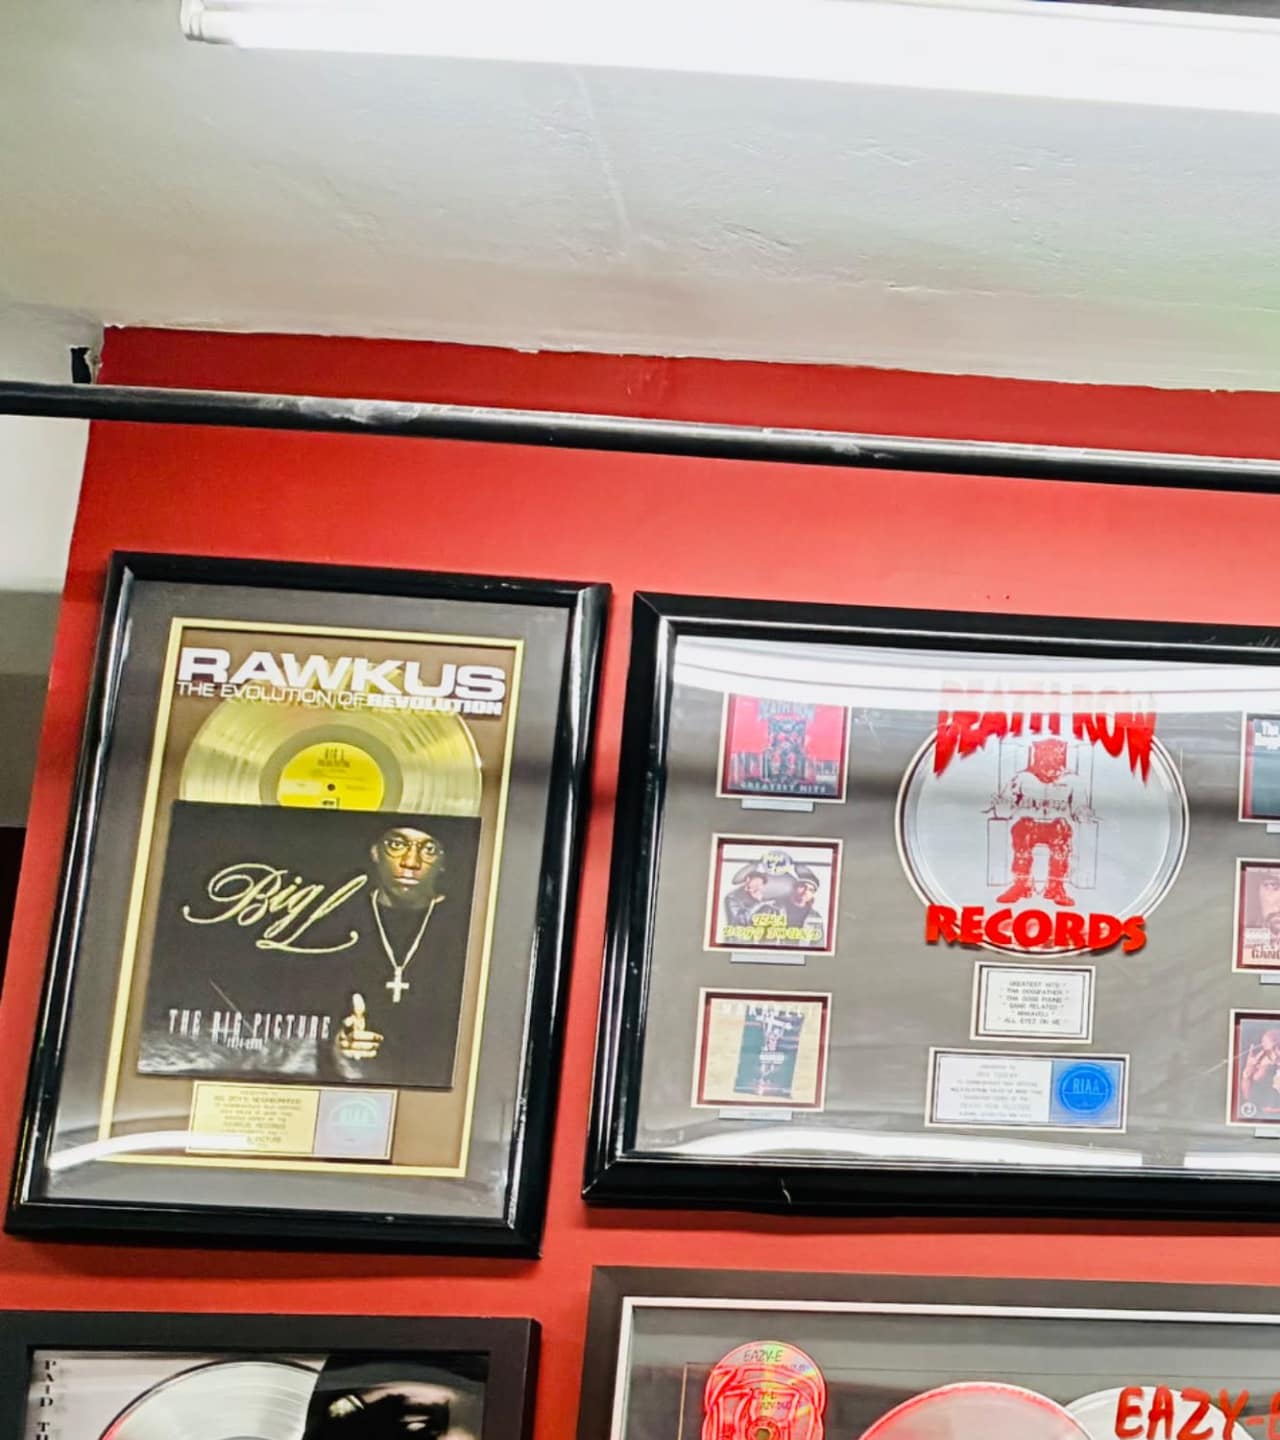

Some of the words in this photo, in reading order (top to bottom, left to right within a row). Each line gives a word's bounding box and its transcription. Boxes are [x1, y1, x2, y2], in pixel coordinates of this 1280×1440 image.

[177, 647, 505, 701] RAWKUS
[177, 682, 214, 698] THE
[220, 683, 333, 706] EVOLUTION
[182, 862, 325, 939] Big
[925, 904, 1148, 955] RECORDS
[169, 1008, 202, 1041] THE
[211, 1010, 243, 1043] BIG
[252, 1012, 331, 1041] PICTURE
[39, 1359, 57, 1407] PAID
